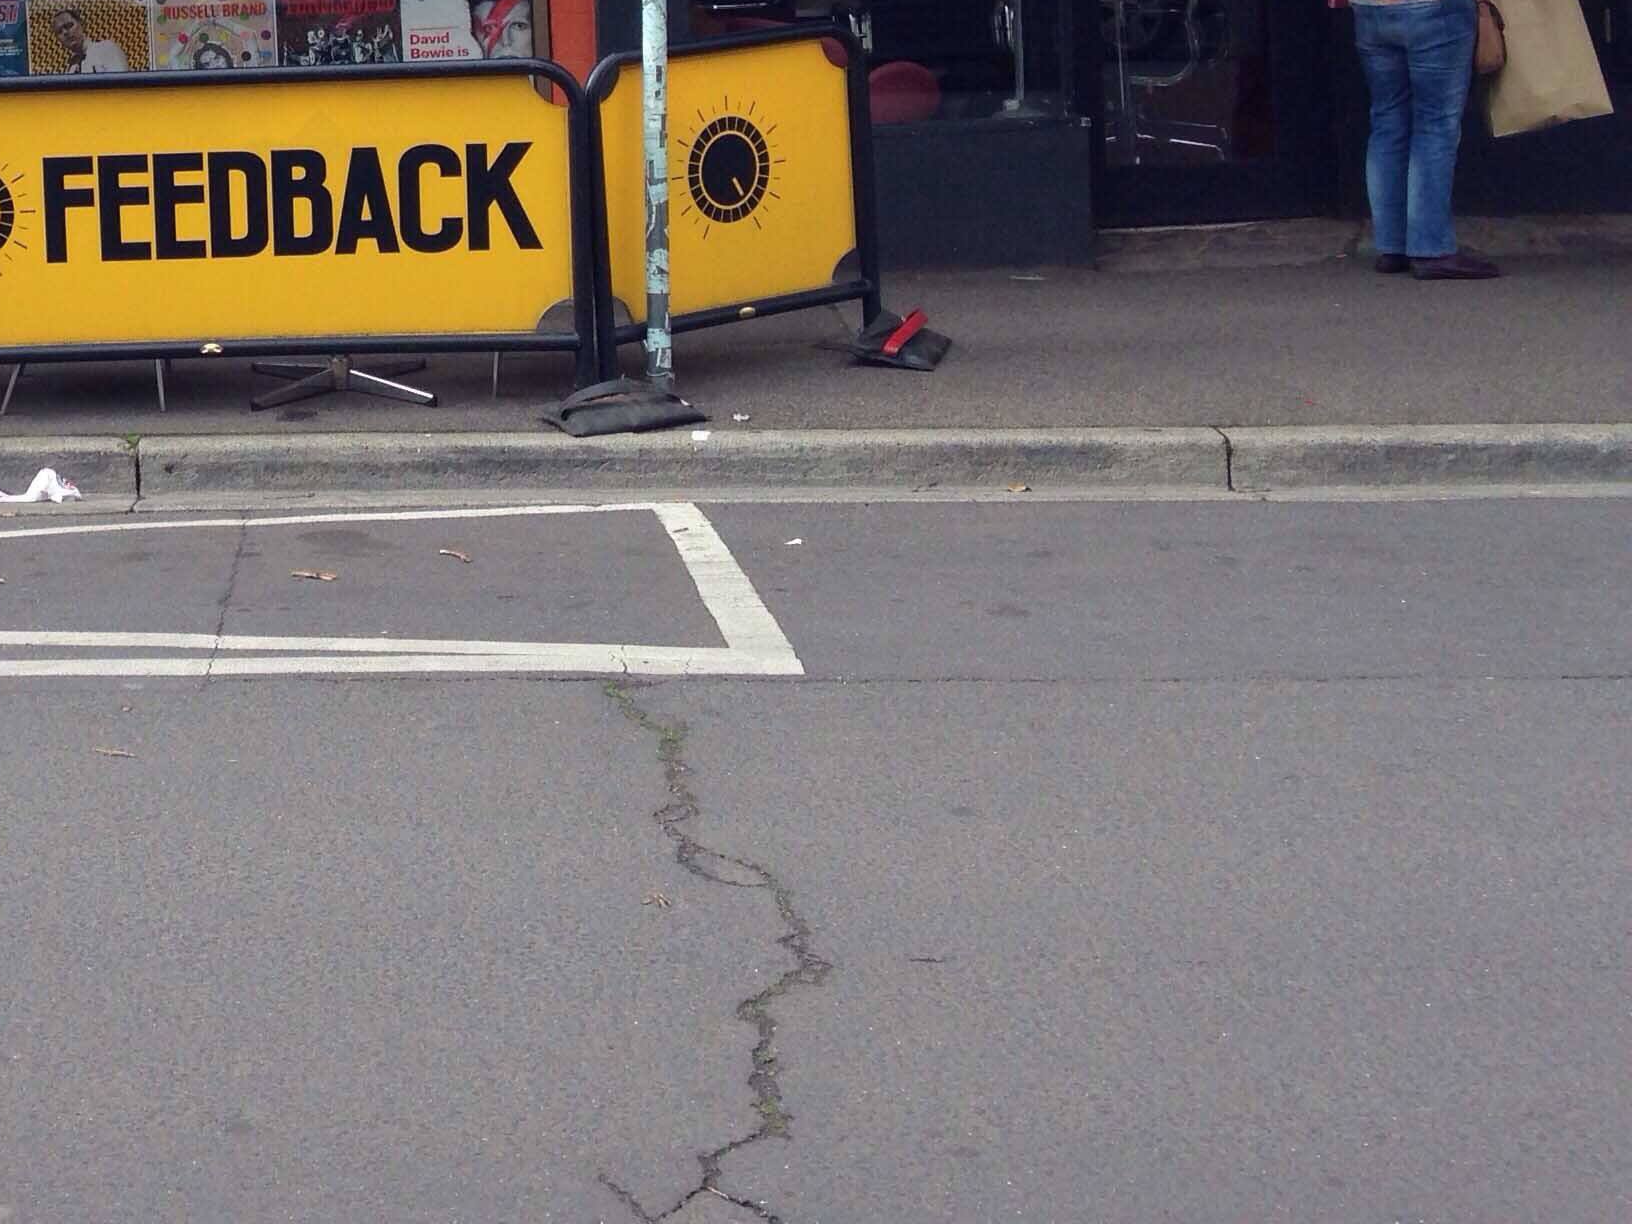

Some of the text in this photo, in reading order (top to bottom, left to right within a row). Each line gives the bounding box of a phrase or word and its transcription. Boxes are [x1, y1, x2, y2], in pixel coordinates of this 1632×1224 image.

[222, 2, 267, 17] BRAND
[410, 31, 449, 45] David
[411, 46, 470, 60] Bowie is
[41, 140, 544, 265] FEEDBACK
